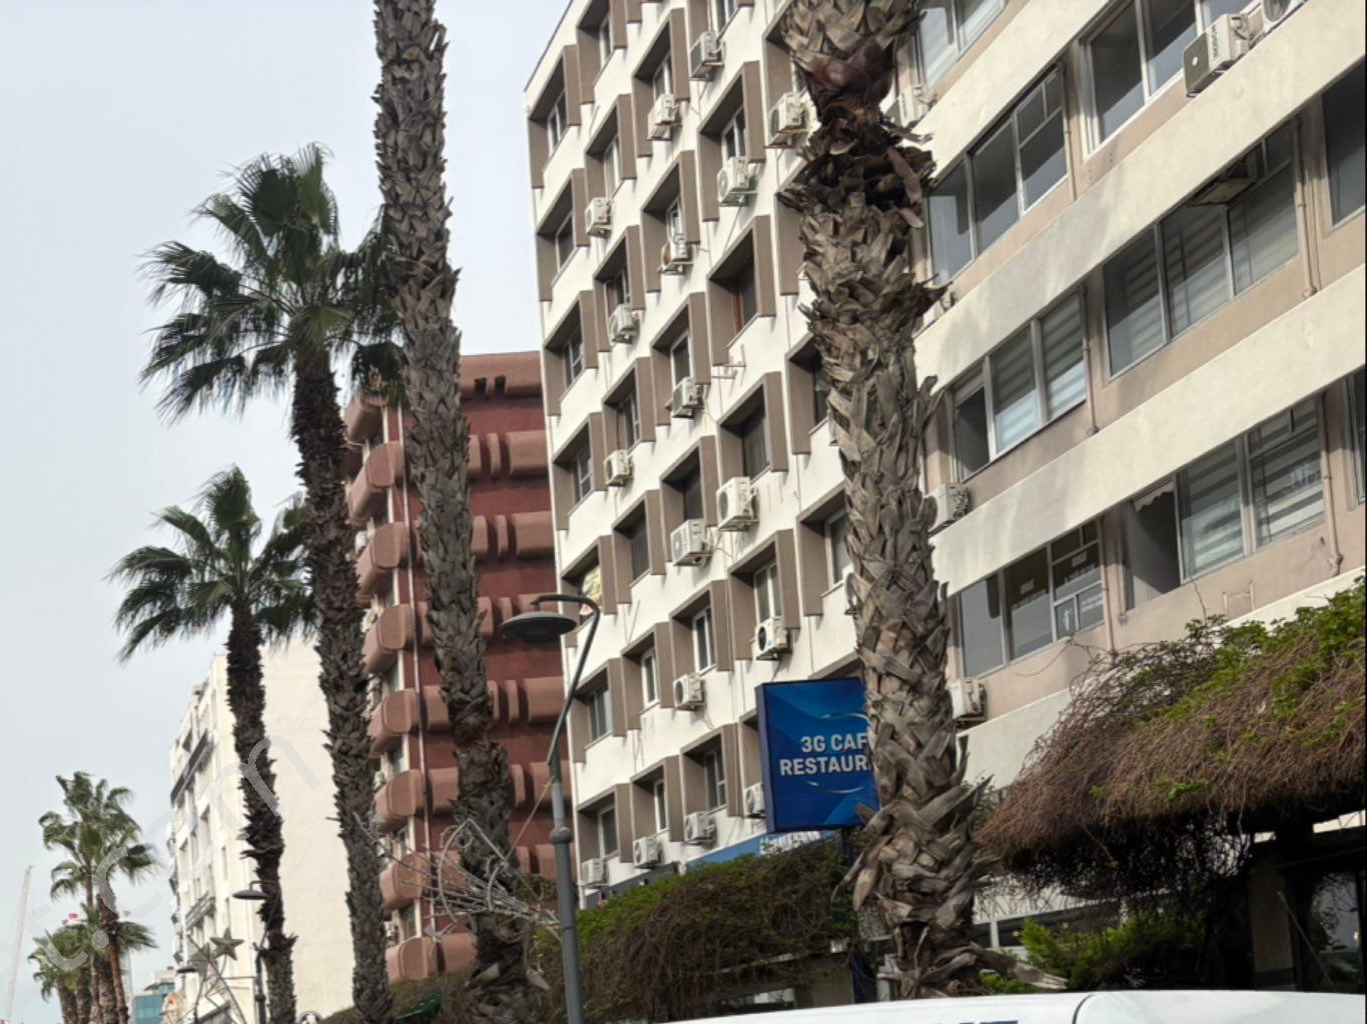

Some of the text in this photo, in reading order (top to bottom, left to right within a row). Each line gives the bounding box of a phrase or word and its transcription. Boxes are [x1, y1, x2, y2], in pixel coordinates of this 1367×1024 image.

[800, 733, 869, 753] 3G CAF
[779, 755, 873, 776] RESTAUR
